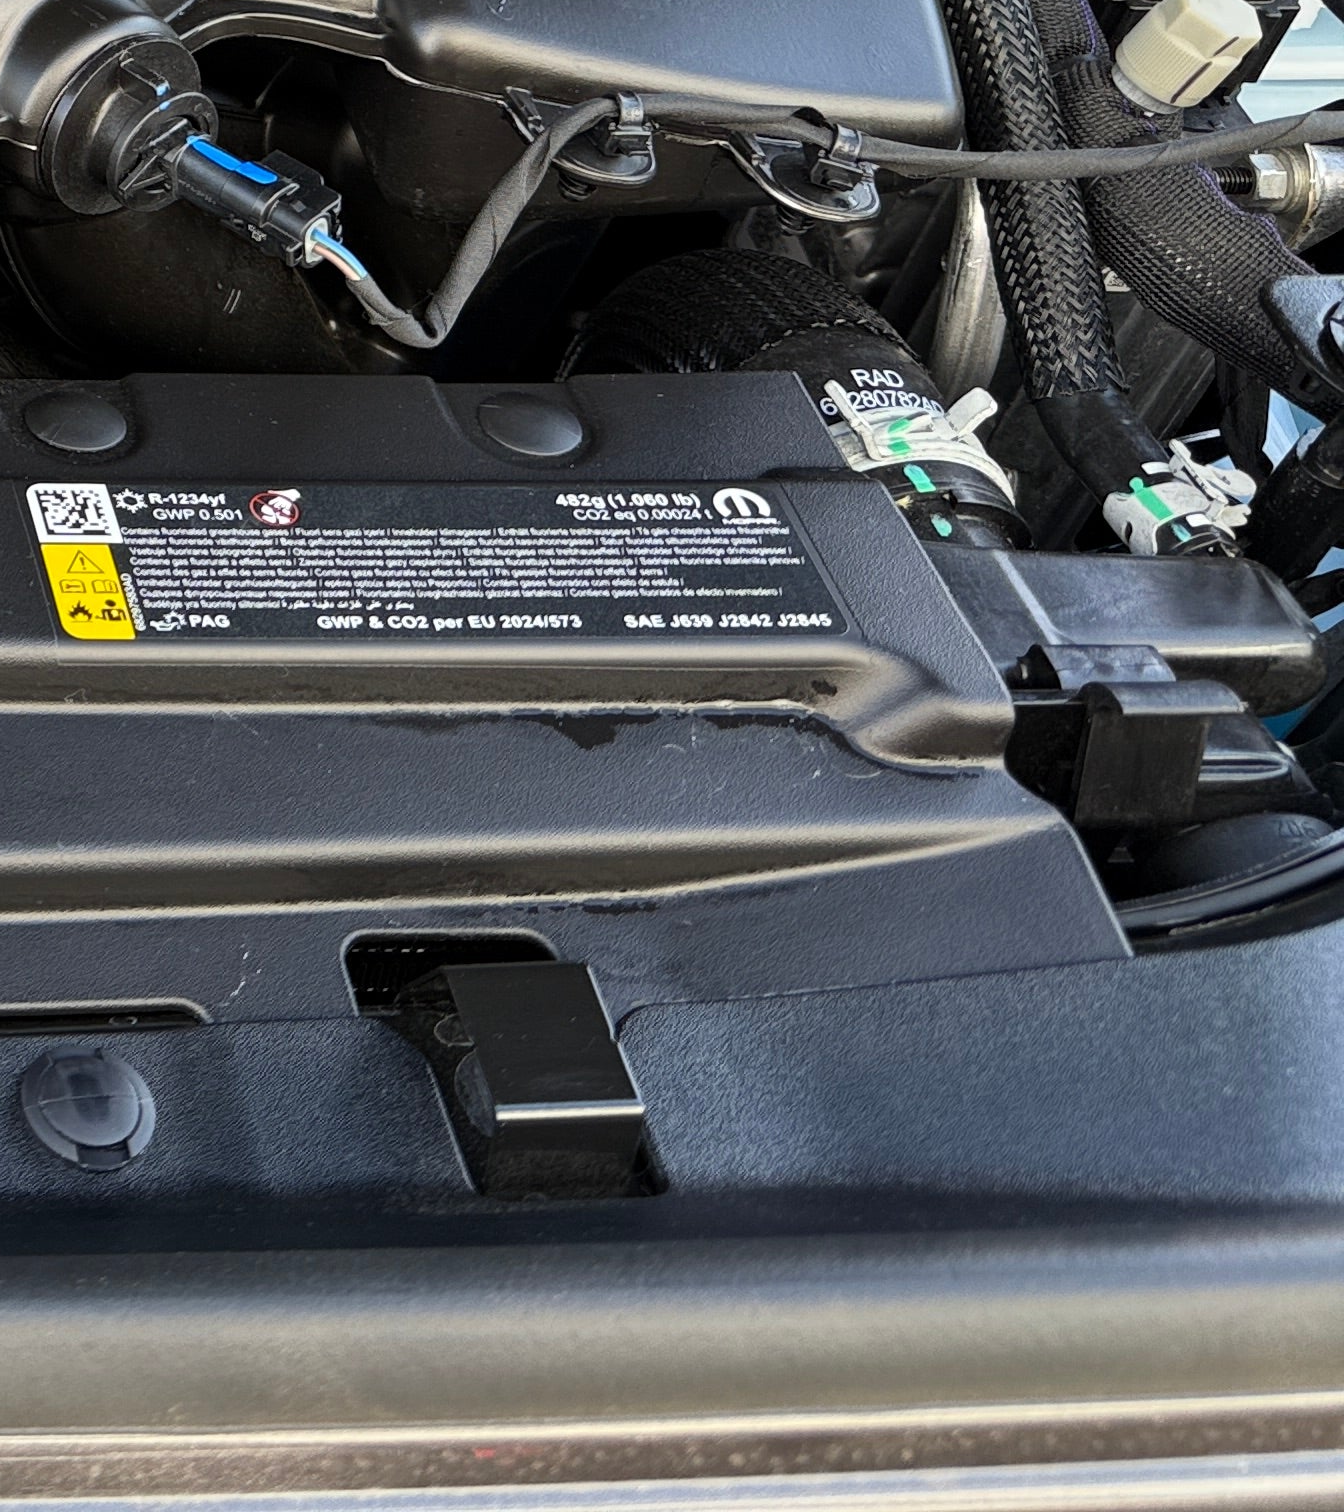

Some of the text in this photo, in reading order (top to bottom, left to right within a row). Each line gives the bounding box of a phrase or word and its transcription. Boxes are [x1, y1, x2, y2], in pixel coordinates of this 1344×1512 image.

[850, 369, 904, 388] RAD
[819, 389, 945, 417] 6280782AD
[147, 493, 225, 507] R-1234yf
[556, 493, 700, 510] 482g (1.060 lb)
[153, 508, 242, 520] GWP 0.501
[573, 508, 611, 520] CO2
[614, 511, 636, 522] eq
[637, 508, 702, 520] 0.00024
[189, 615, 230, 628] PAG
[317, 615, 582, 631] GWP & CO2 per EU 2024/573
[624, 613, 832, 628] SAE J639 J2842 J2845
